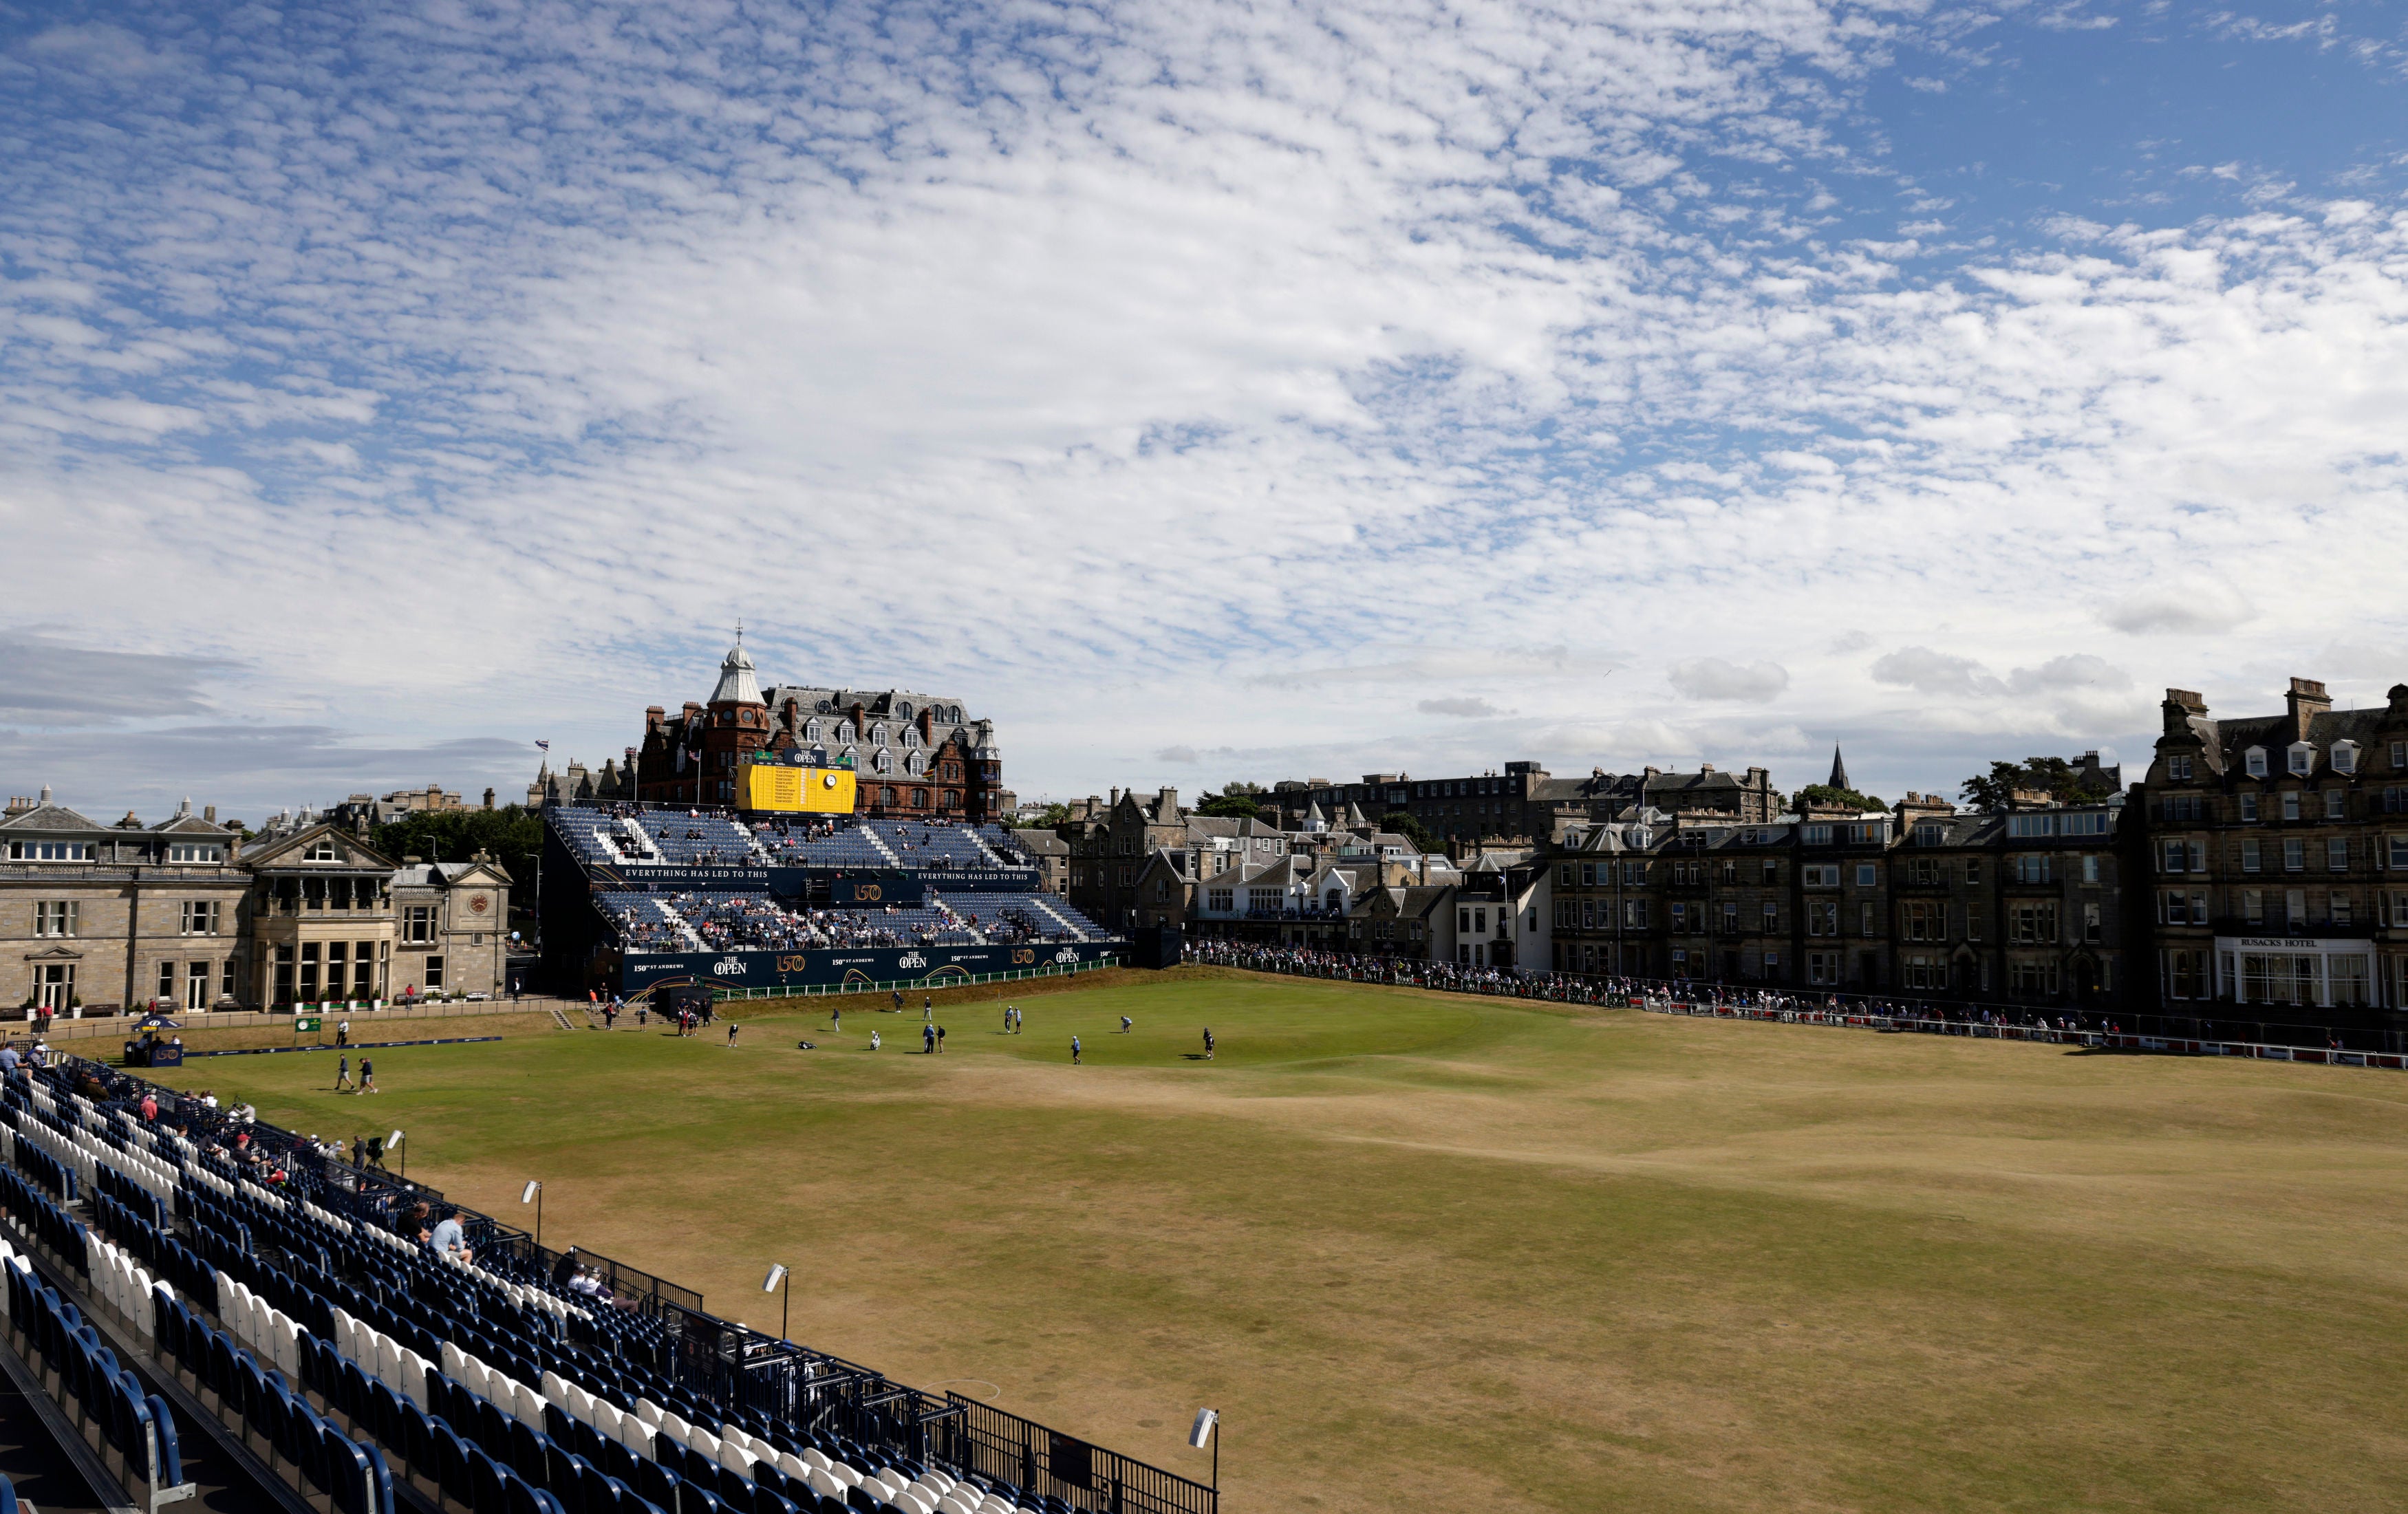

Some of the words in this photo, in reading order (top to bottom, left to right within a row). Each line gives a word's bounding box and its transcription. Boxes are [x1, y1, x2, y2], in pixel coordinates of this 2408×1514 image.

[795, 754, 816, 764] OPEN
[854, 885, 881, 900] 150
[1011, 949, 1035, 963] 150
[1056, 952, 1079, 962] OPEN
[714, 962, 746, 975] OPEN
[776, 955, 805, 972] 150
[899, 957, 927, 969] OPEN
[155, 1049, 179, 1060] 150
